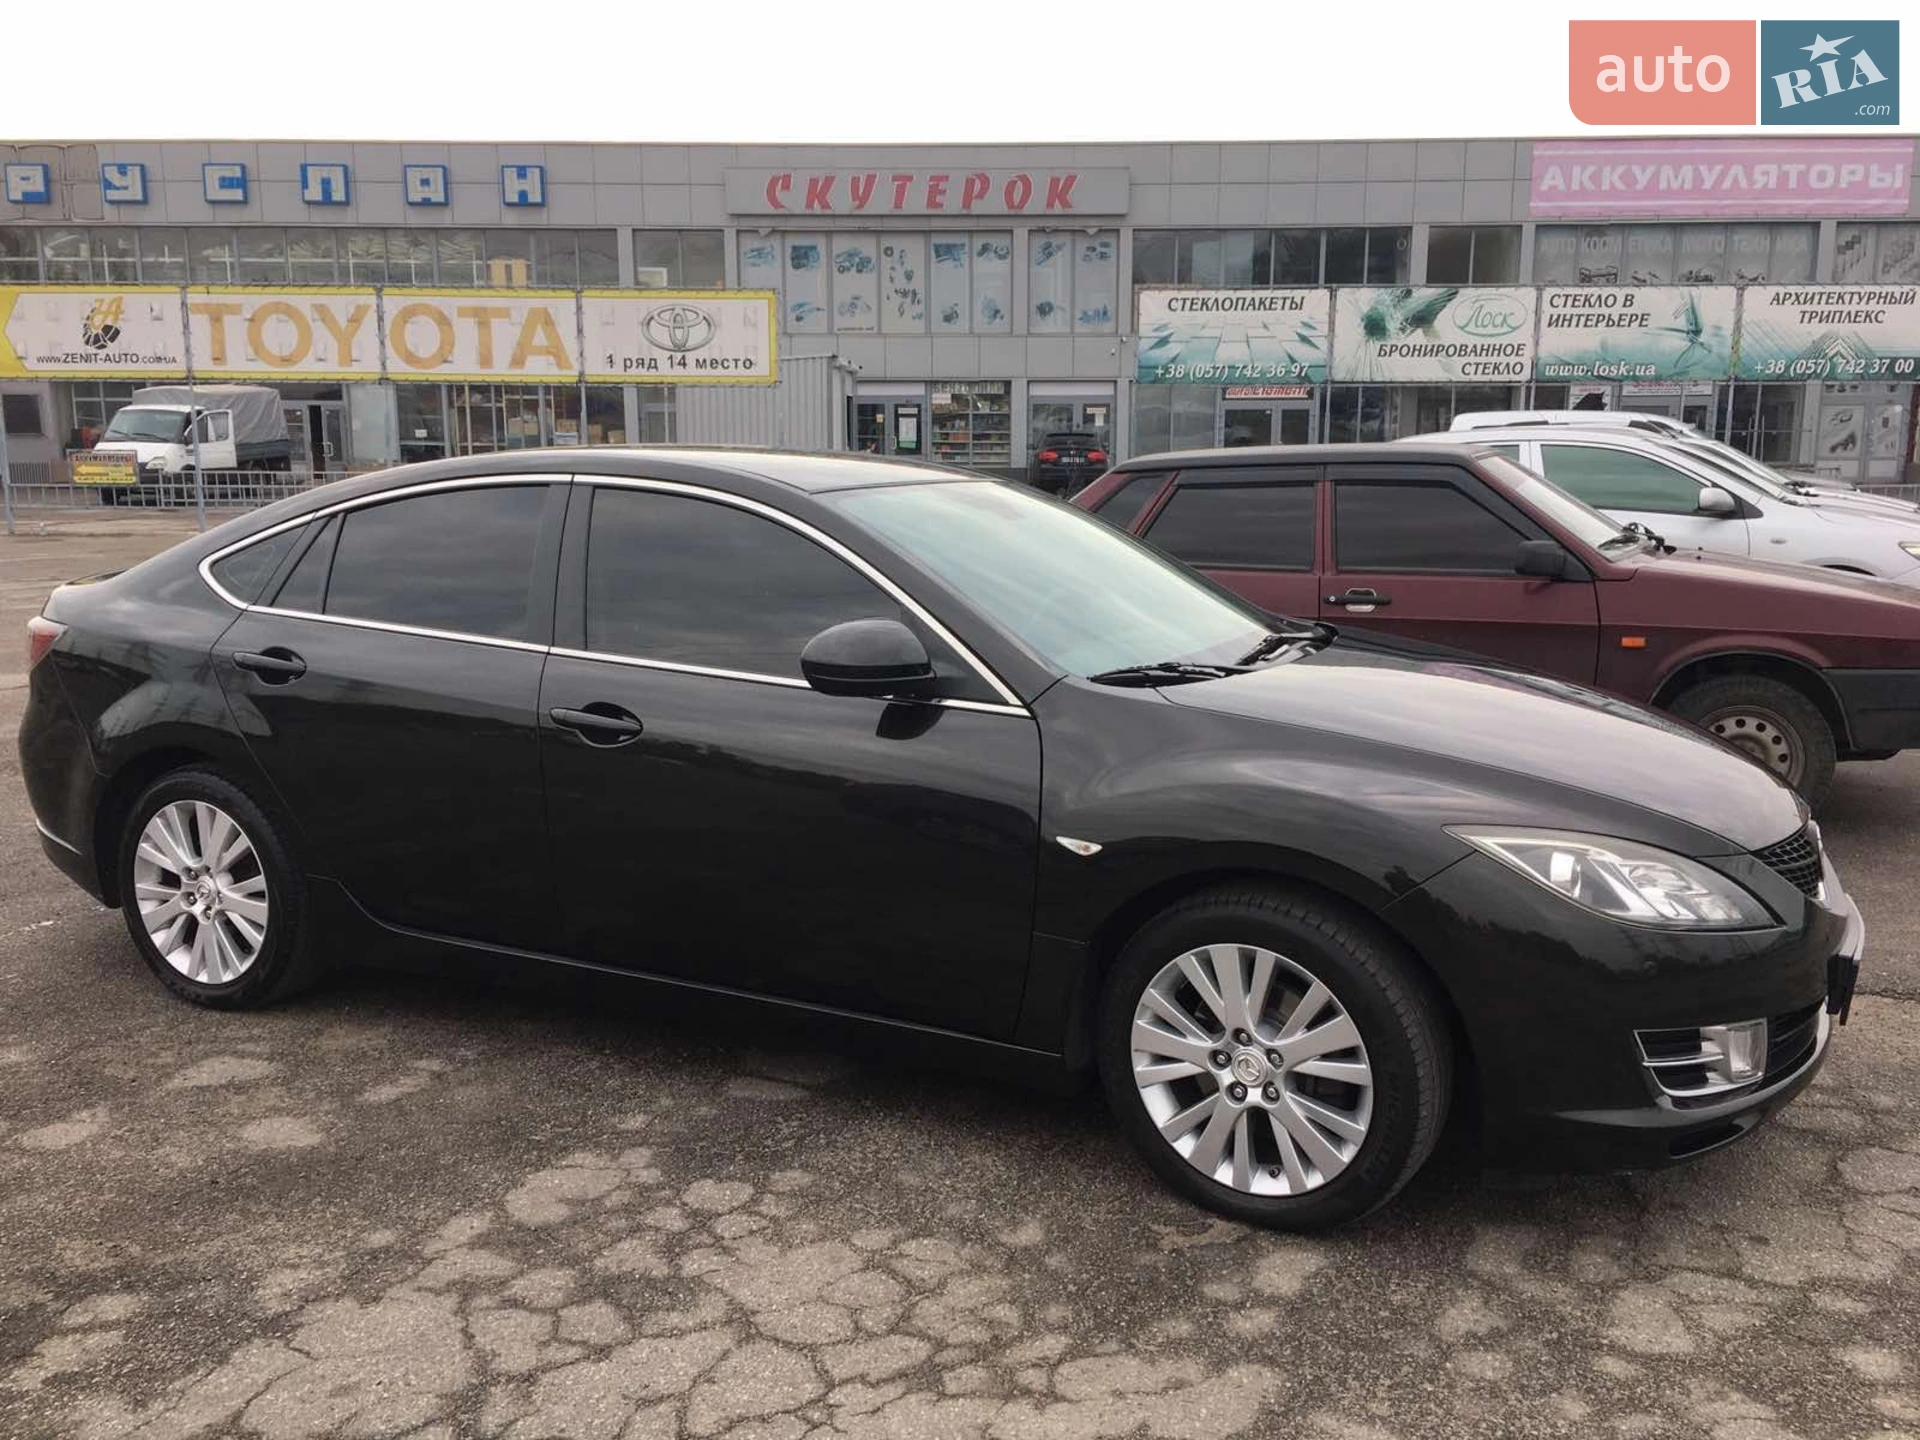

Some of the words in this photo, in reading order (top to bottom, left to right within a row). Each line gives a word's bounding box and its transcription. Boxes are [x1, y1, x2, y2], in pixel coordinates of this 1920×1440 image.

[4, 163, 546, 206] РУСЛАН
[1540, 163, 1904, 191] АККУМУЛЯТОРЫ
[766, 172, 1083, 211] СКУТЕРОК
[1168, 296, 1306, 312] СТЕКЛОПАКЕТЫ
[1549, 293, 1620, 309] СТЕКЛО
[1622, 293, 1636, 309] В
[1769, 288, 1918, 306] АРХИТЕКТУРНЫЙ
[1463, 303, 1516, 329] Лоск
[1547, 313, 1652, 328] ИНТЕРЬЕРЕ
[1799, 309, 1887, 324] ТРИПЛЕКС
[190, 301, 574, 371] TOYOTA
[1377, 343, 1526, 358] БРОНИРОВАННОЕ
[606, 354, 614, 369] 1
[623, 357, 659, 372] ряд
[667, 354, 688, 369] 14
[695, 358, 754, 370] место
[1461, 361, 1525, 376] СТЕКЛО
[1544, 360, 1657, 377] www.losk.ua
[1754, 359, 1786, 374] +38
[1790, 359, 1831, 377] (057)
[1836, 359, 1865, 374] 742
[1869, 359, 1891, 373] 37
[1894, 358, 1915, 373] 00
[1155, 364, 1184, 378] +38
[1189, 364, 1229, 381] (057)
[1234, 364, 1262, 378] 742
[1266, 364, 1286, 378] 36
[1290, 364, 1309, 377] 97
